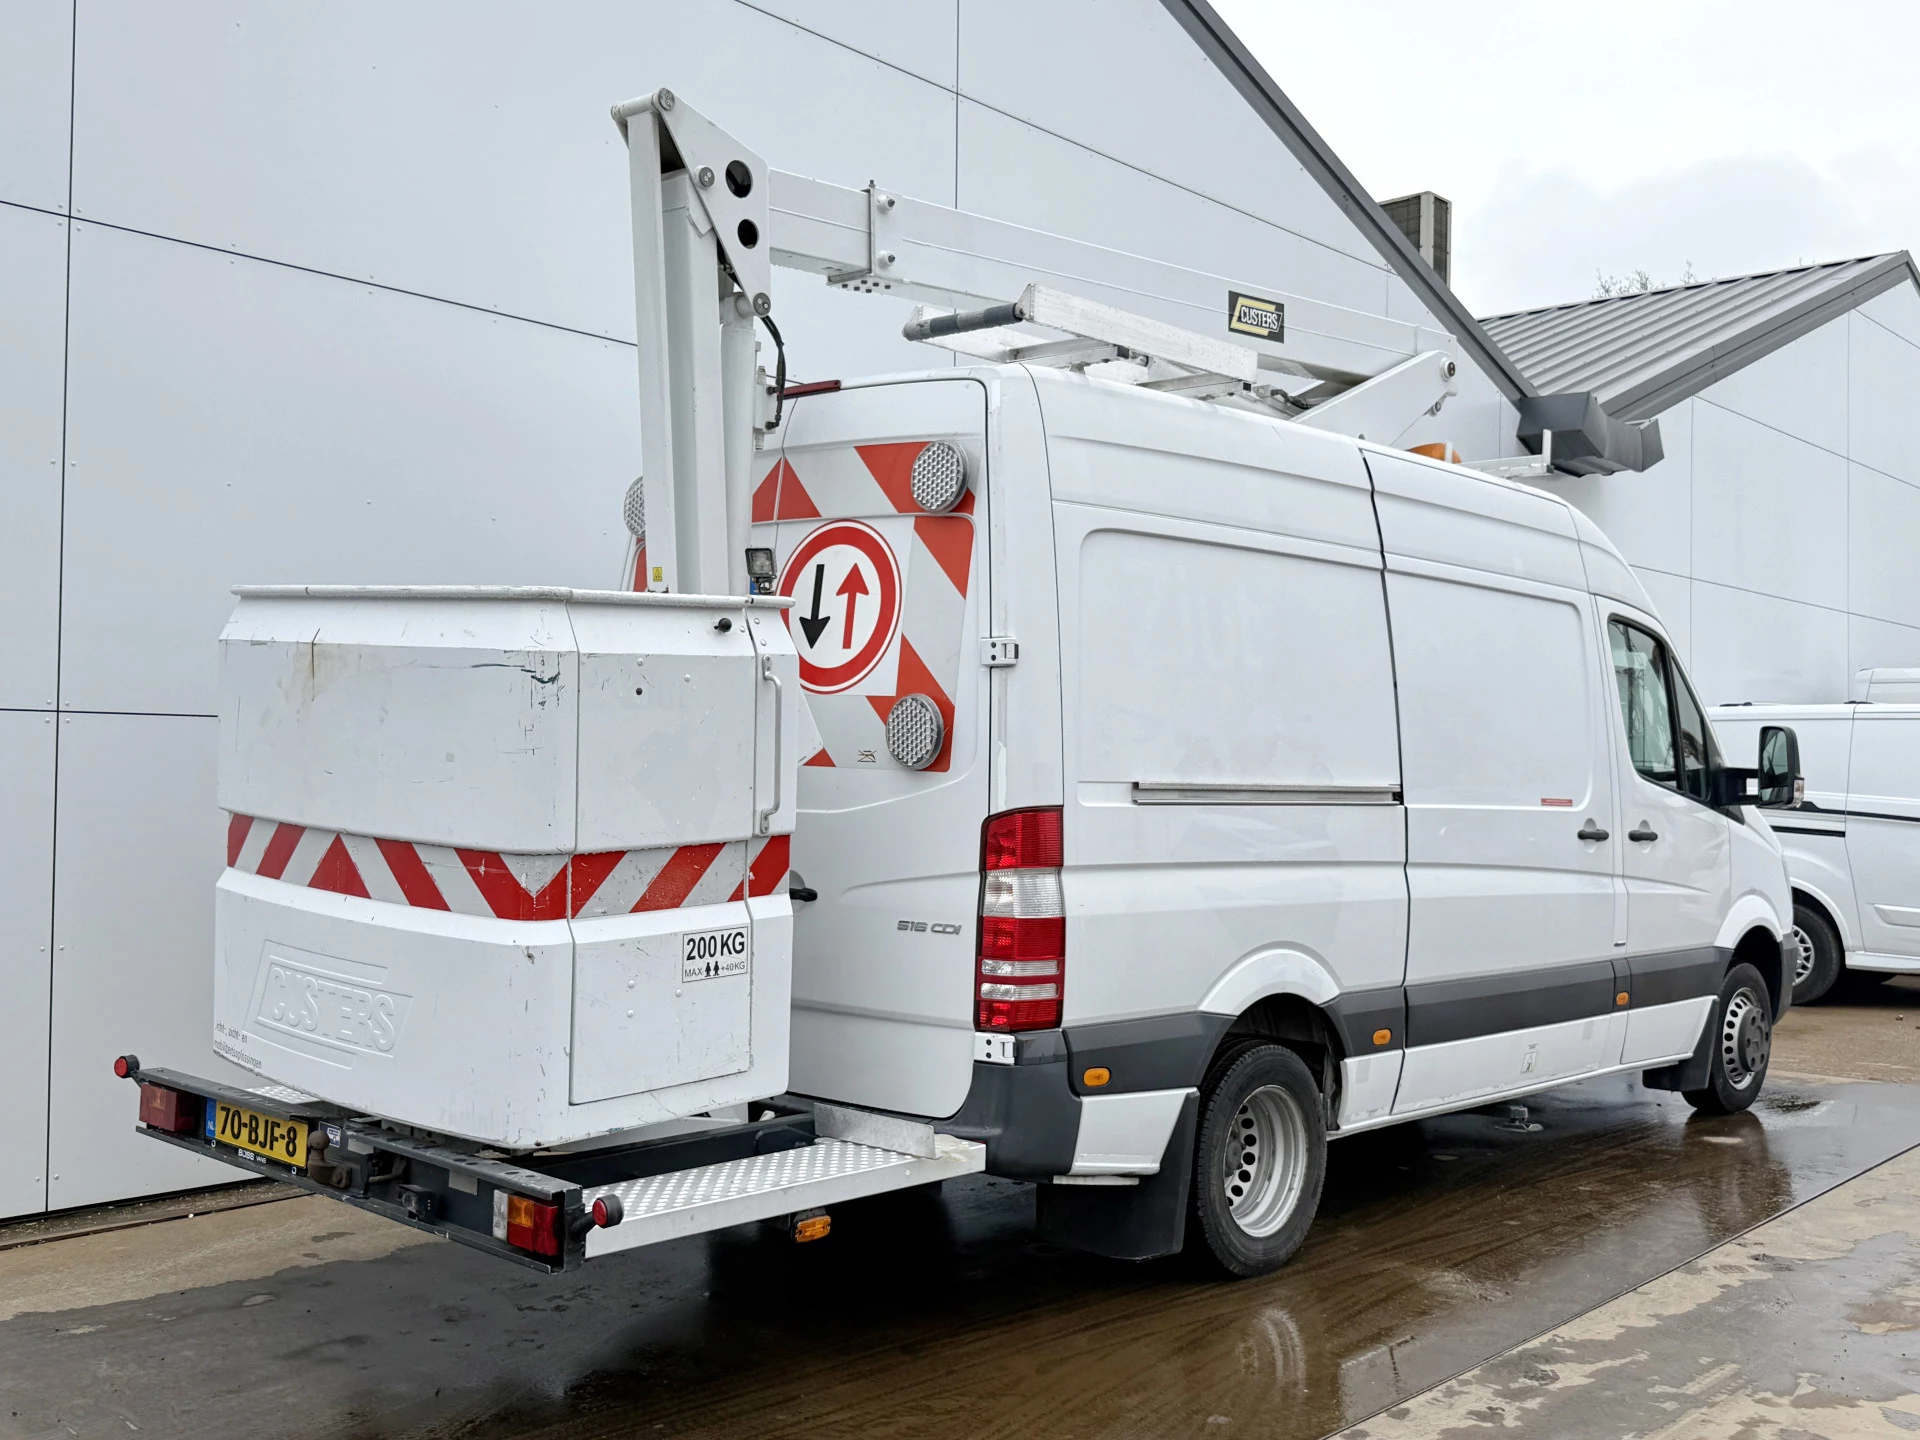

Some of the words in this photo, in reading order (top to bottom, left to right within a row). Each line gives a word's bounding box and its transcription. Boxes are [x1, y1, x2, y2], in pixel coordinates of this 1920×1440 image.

[1240, 306, 1278, 330] CUSTERS
[930, 922, 962, 935] CDI
[684, 967, 703, 978] MAX
[207, 1121, 215, 1131] NL
[220, 1106, 298, 1158] 70-BJF-8
[238, 1148, 255, 1161] BOSS
